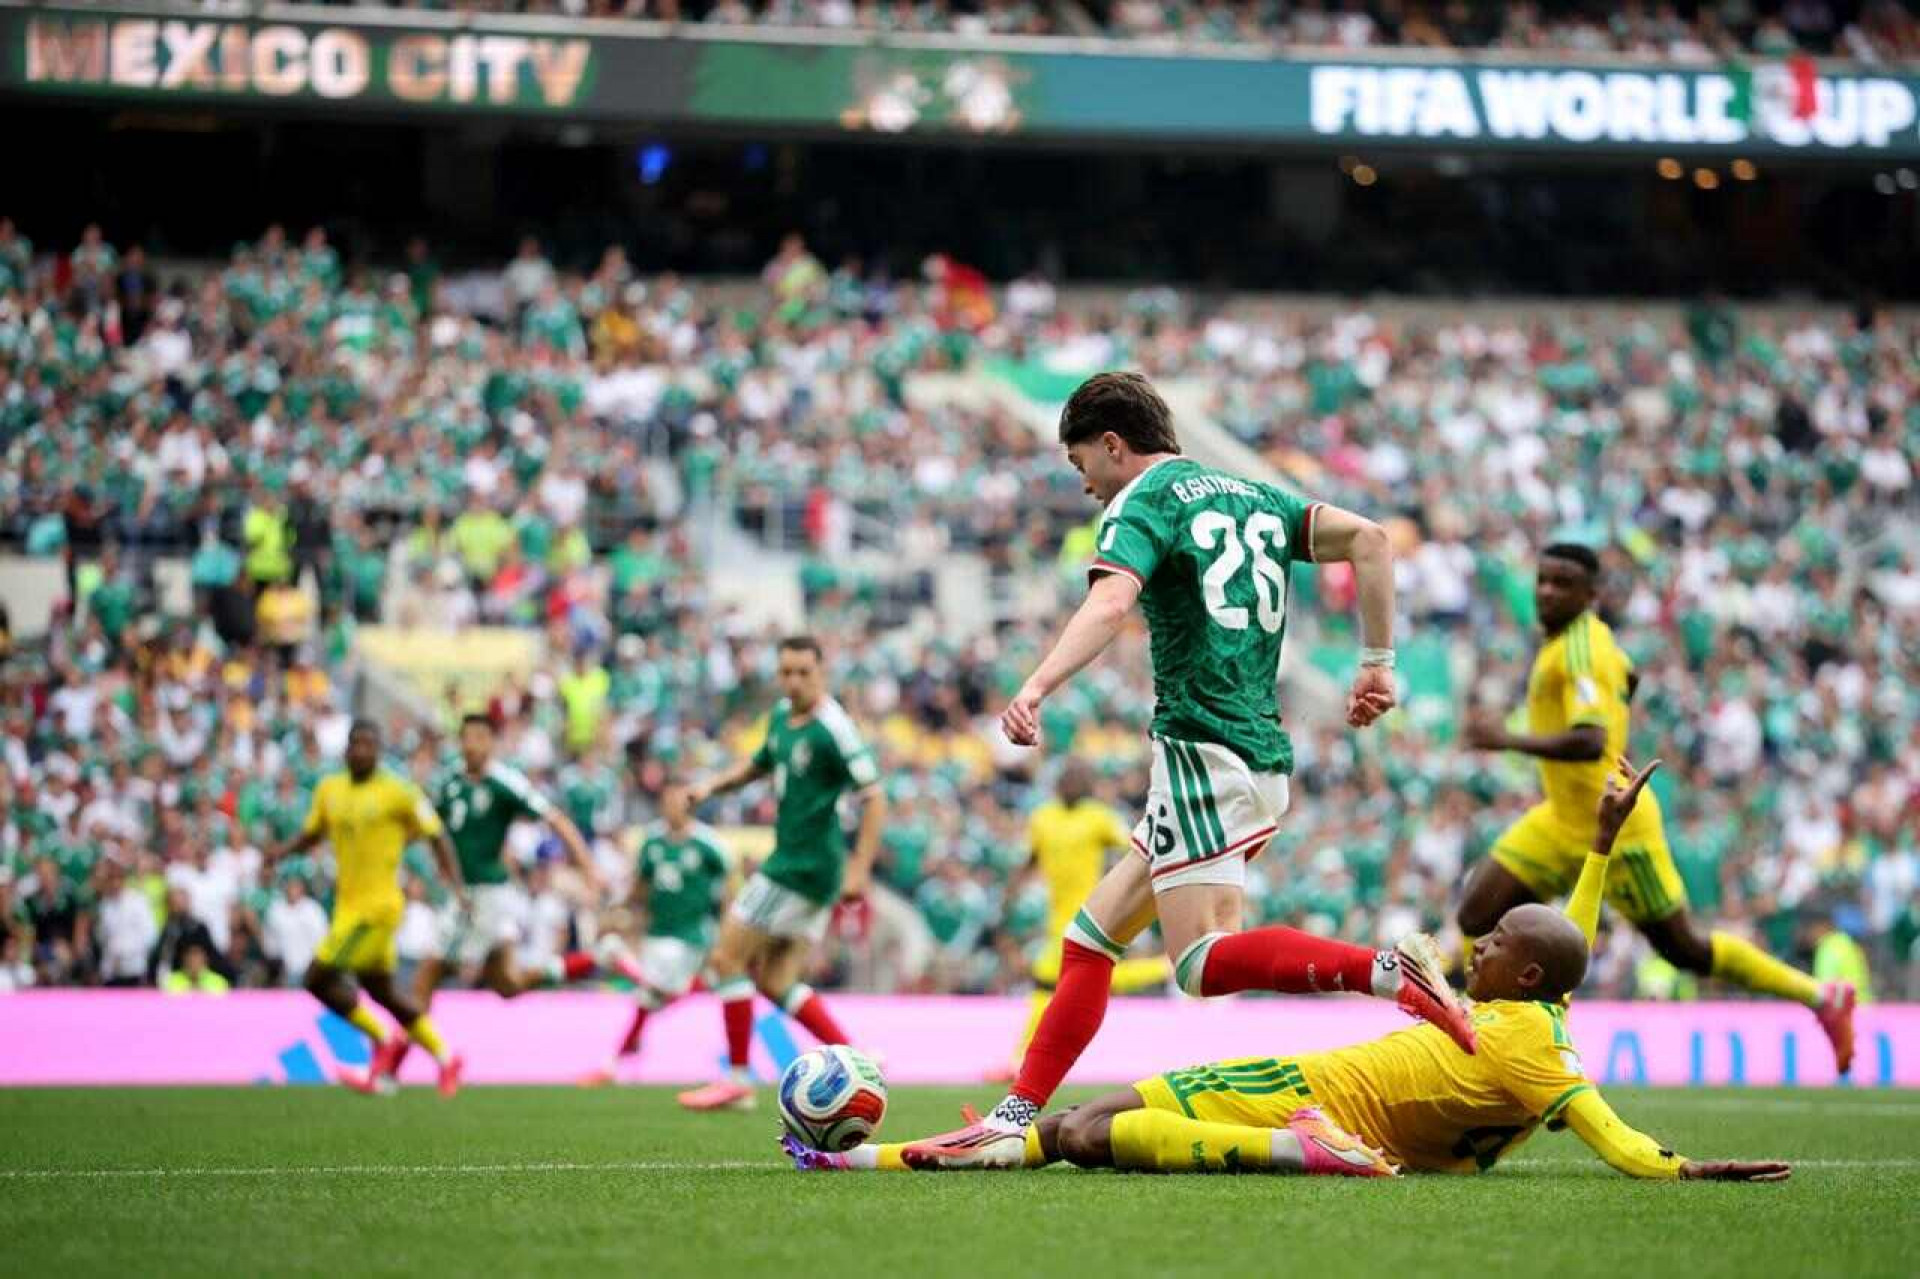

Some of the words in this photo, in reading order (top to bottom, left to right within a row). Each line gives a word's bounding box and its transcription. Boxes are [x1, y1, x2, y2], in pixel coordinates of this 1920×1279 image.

[25, 17, 369, 99] MEXICO
[387, 35, 591, 107] CITY
[1310, 65, 1477, 138] FIFA
[1191, 510, 1287, 634] 26
